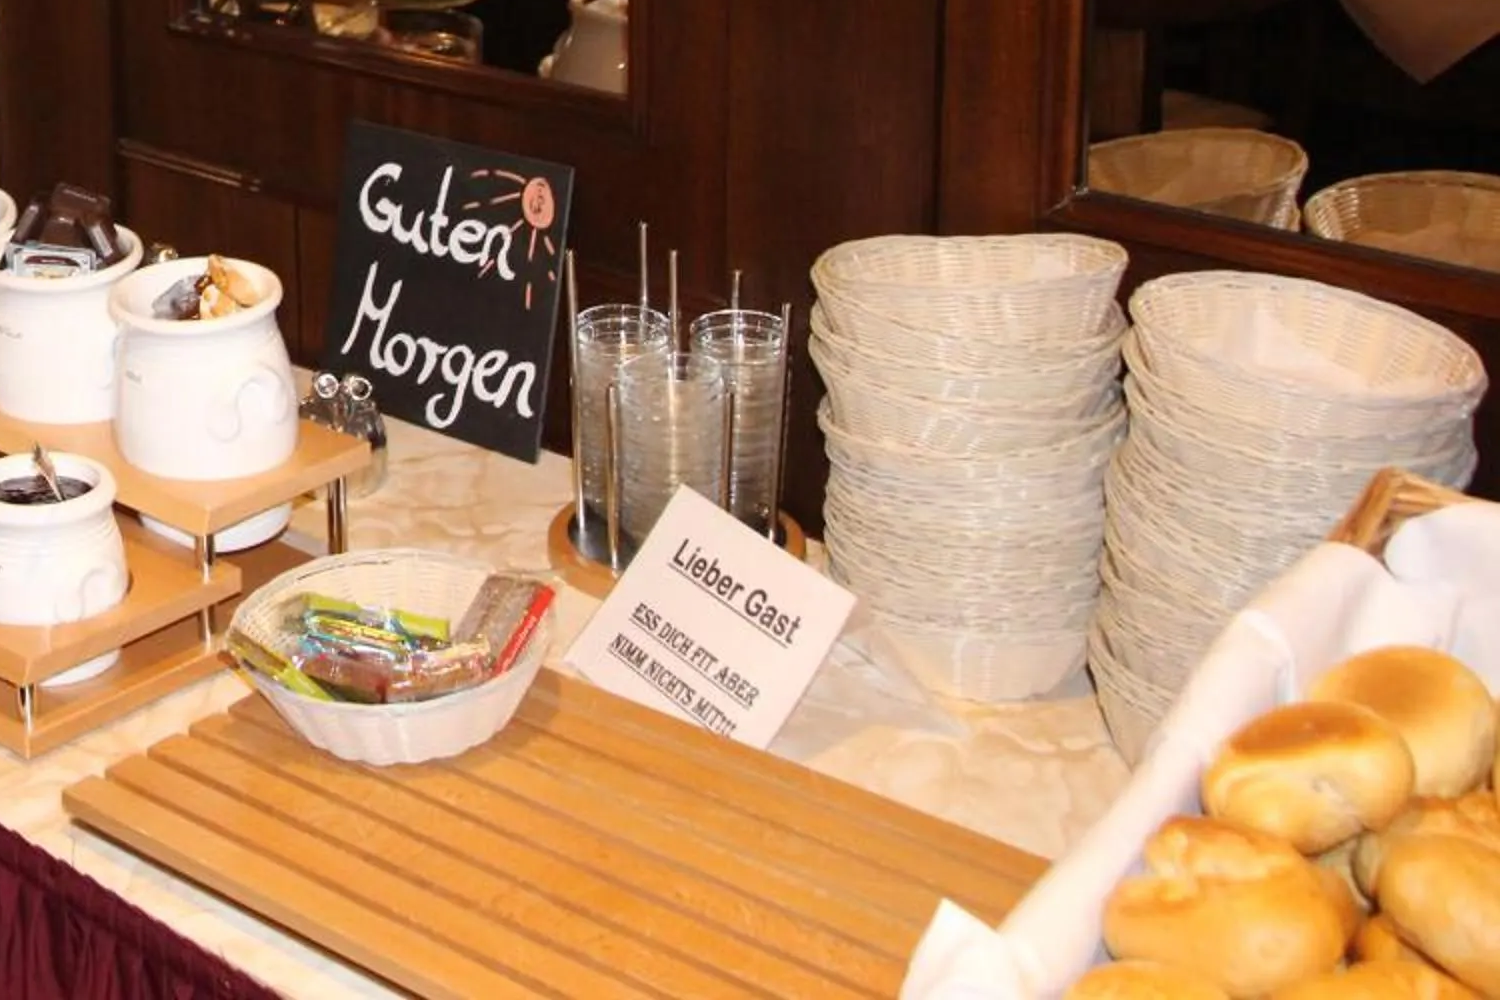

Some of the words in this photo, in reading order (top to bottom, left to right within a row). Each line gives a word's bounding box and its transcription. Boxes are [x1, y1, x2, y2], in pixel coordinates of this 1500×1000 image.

[358, 162, 515, 280] Guten
[341, 261, 536, 429] Morgen
[671, 538, 745, 602] Lieber
[744, 588, 802, 645] Gast
[610, 632, 650, 669] NIMM
[645, 660, 697, 706] NICHTS
[631, 602, 662, 632] ESS
[658, 622, 695, 656] DICH
[690, 646, 719, 673] FIT
[714, 666, 760, 708] ABER
